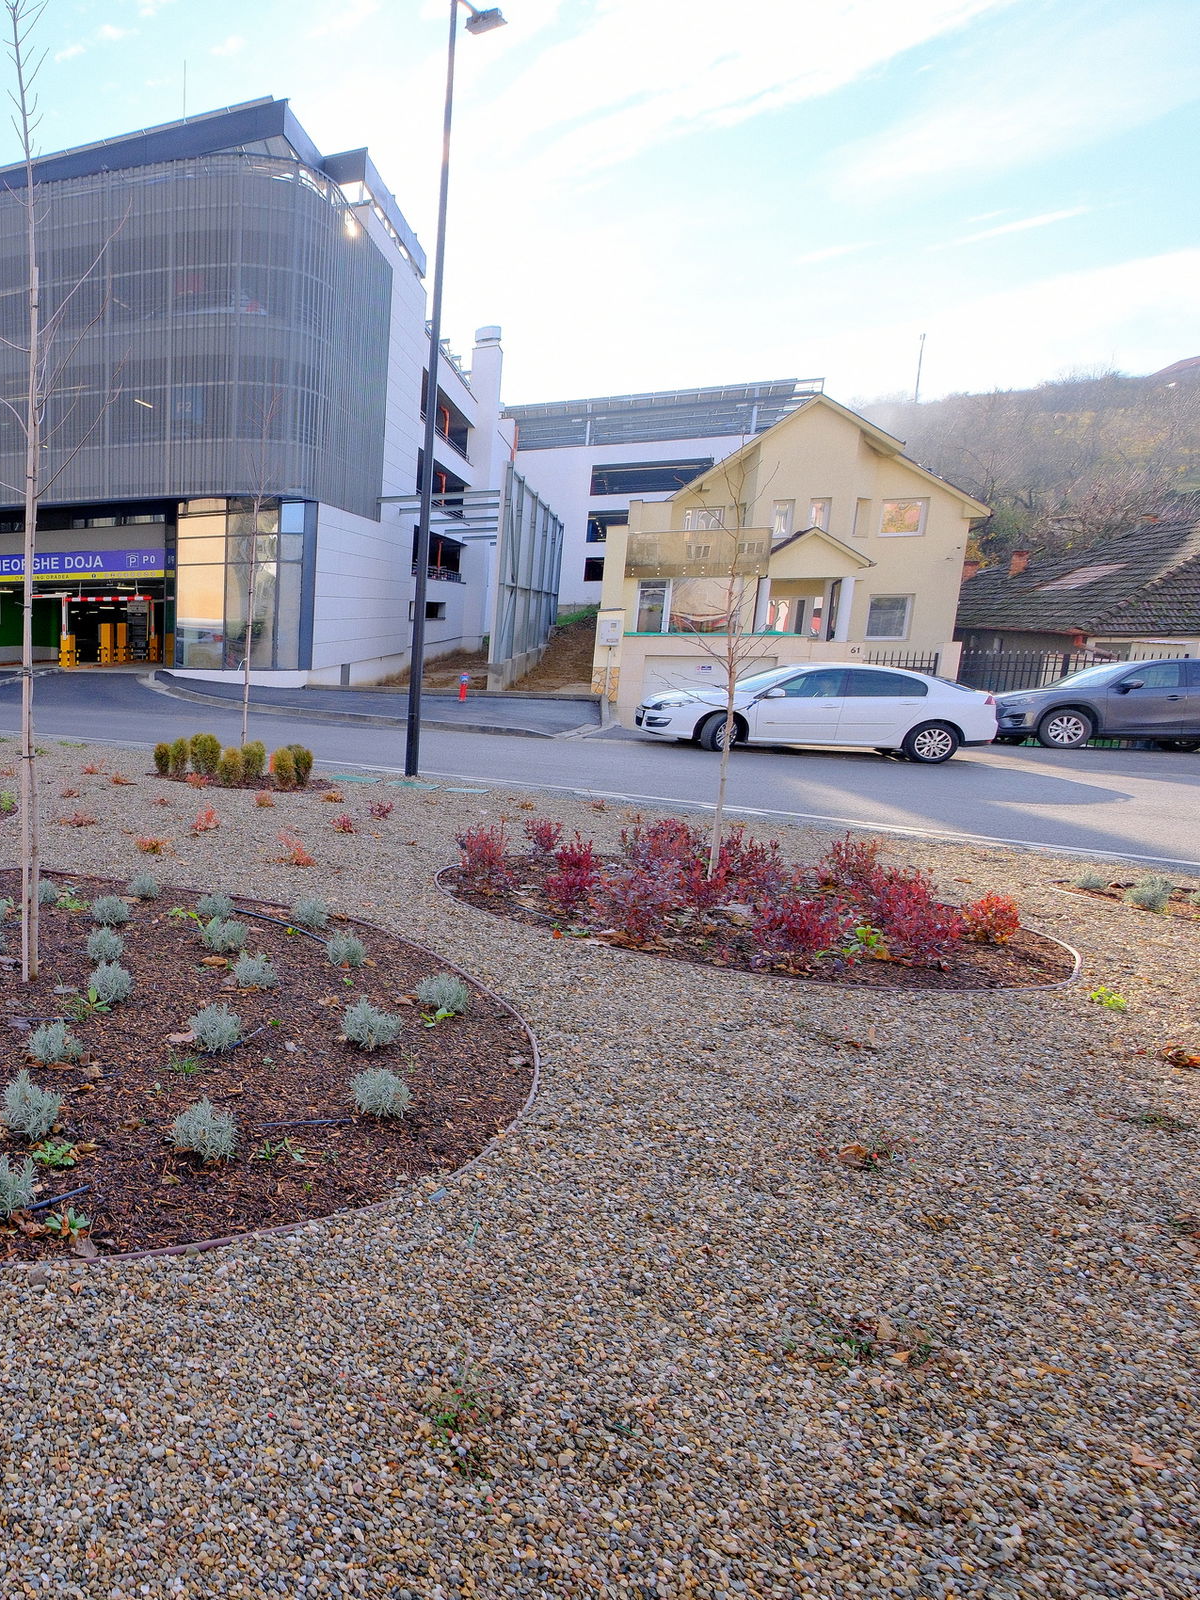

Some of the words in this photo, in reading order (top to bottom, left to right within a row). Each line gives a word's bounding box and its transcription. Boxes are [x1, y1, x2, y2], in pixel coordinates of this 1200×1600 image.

[65, 555, 103, 569] DOJA
[142, 555, 156, 564] P0
[850, 646, 860, 654] 61
